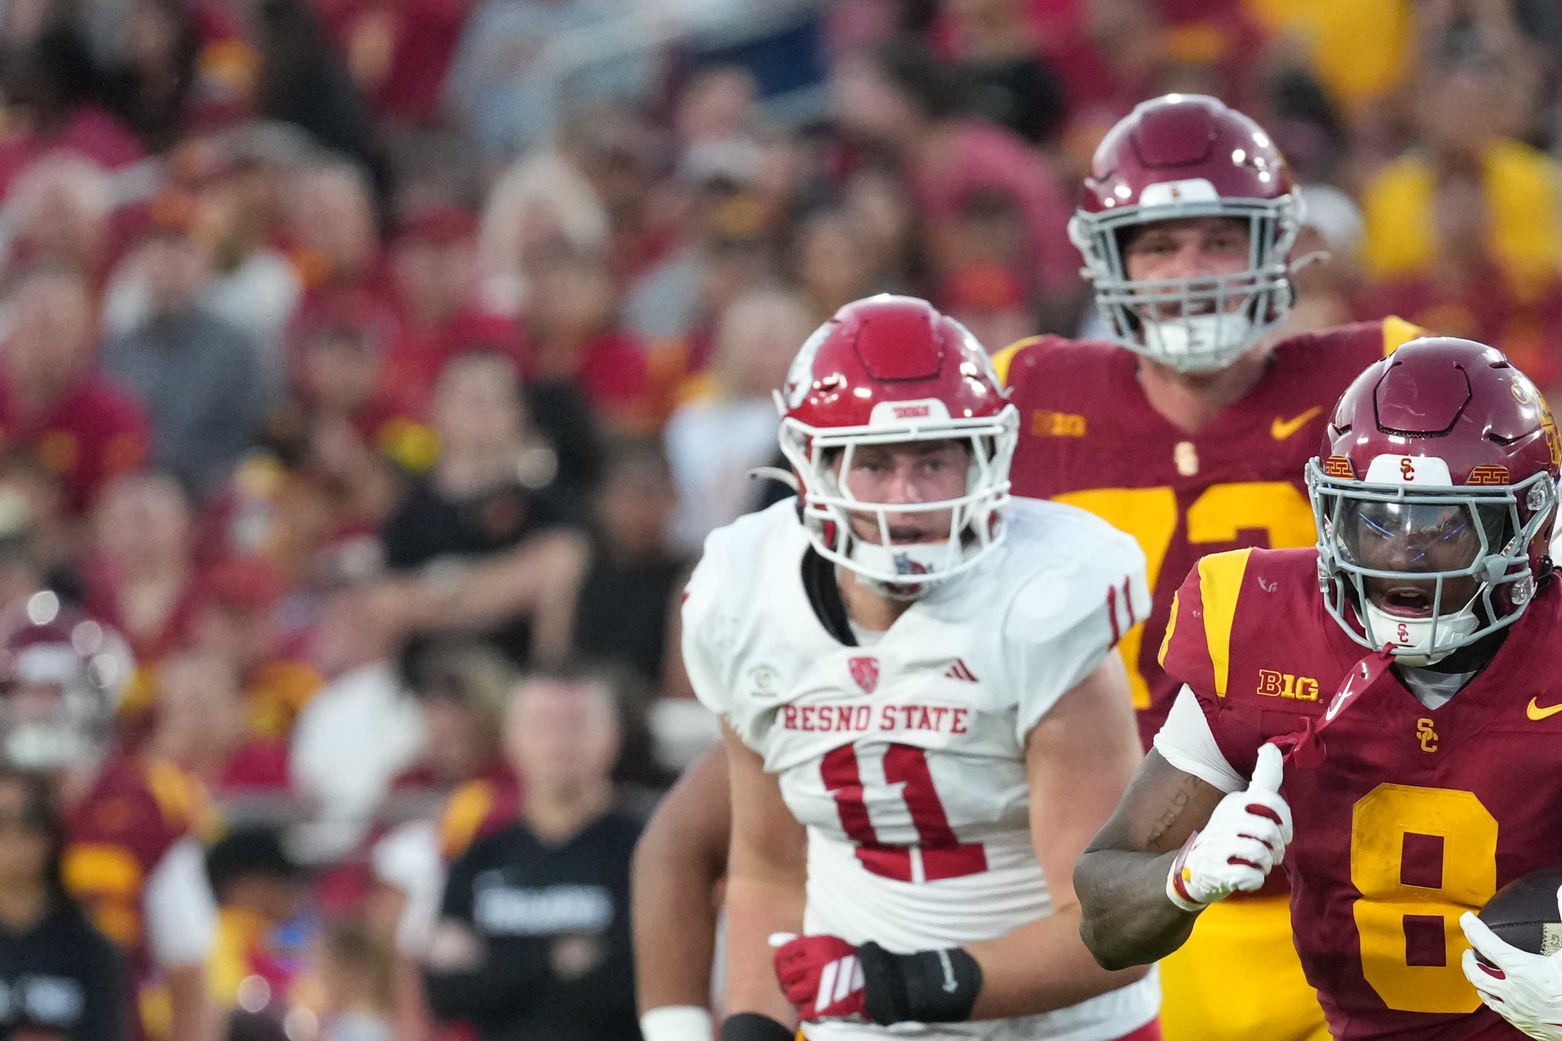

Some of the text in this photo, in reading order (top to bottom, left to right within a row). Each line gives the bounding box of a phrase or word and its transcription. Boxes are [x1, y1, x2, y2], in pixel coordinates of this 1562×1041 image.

[782, 705, 968, 734] RESNO STATE
[1417, 718, 1438, 753] SC
[820, 742, 990, 882] 11
[1351, 782, 1499, 1014] 8
